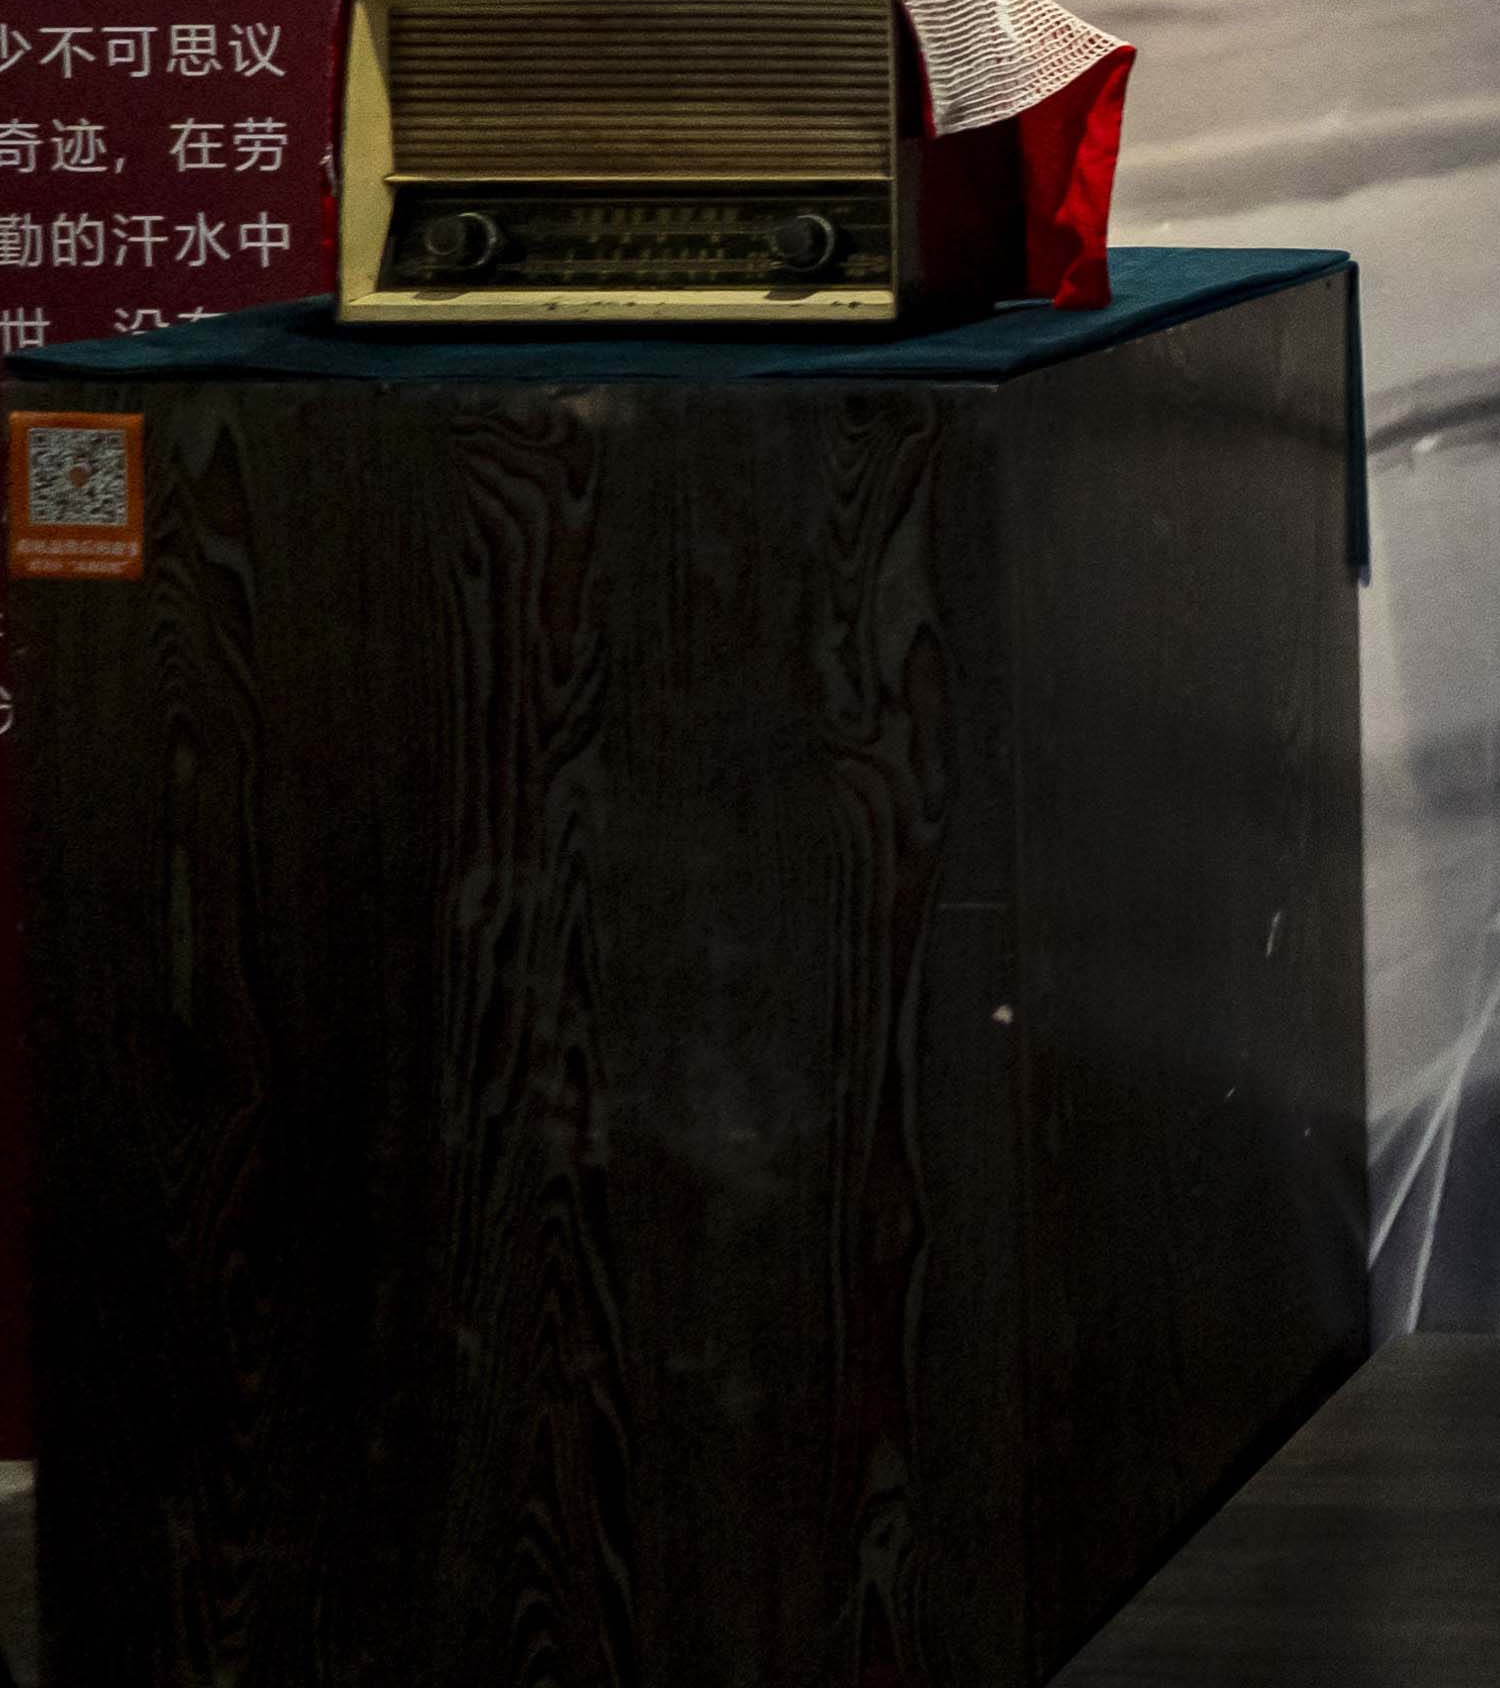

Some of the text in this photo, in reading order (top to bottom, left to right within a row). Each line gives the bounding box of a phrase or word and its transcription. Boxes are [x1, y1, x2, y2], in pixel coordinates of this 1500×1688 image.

[0, 212, 290, 268] 勤的汗水中
